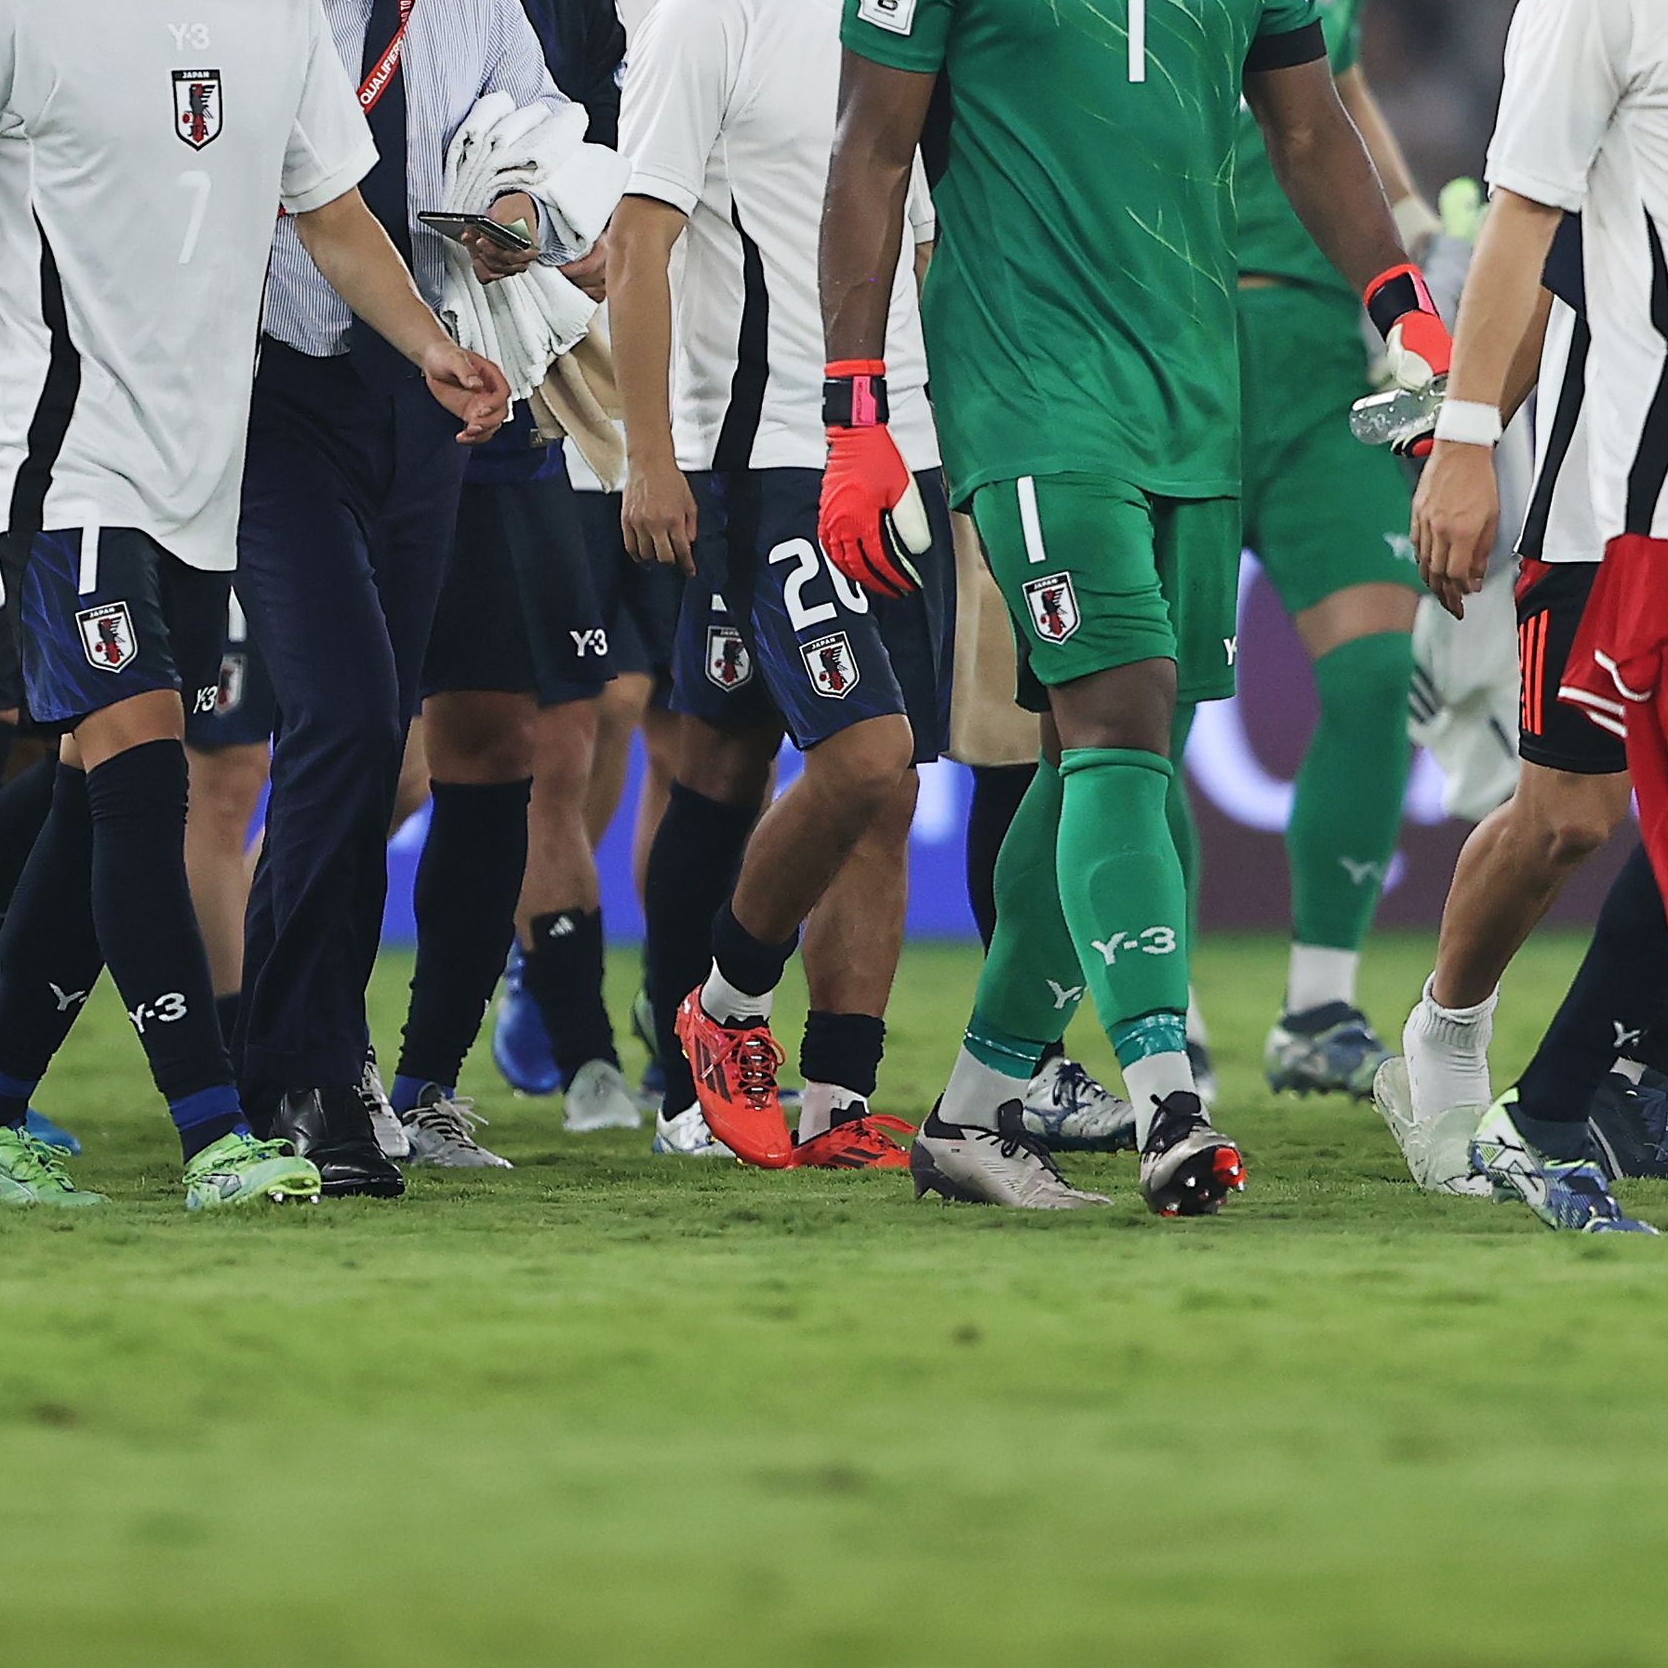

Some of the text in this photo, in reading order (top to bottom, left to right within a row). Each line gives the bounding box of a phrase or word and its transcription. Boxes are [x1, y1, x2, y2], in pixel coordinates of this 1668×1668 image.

[168, 23, 211, 51] Y-3
[173, 170, 211, 264] 7
[1033, 578, 1058, 590] JAPAN
[89, 607, 115, 618] JAPAN
[569, 628, 608, 657] Y-3
[812, 637, 836, 649] JAPAN
[1091, 926, 1176, 965] Y-3
[128, 993, 187, 1033] Y-3
